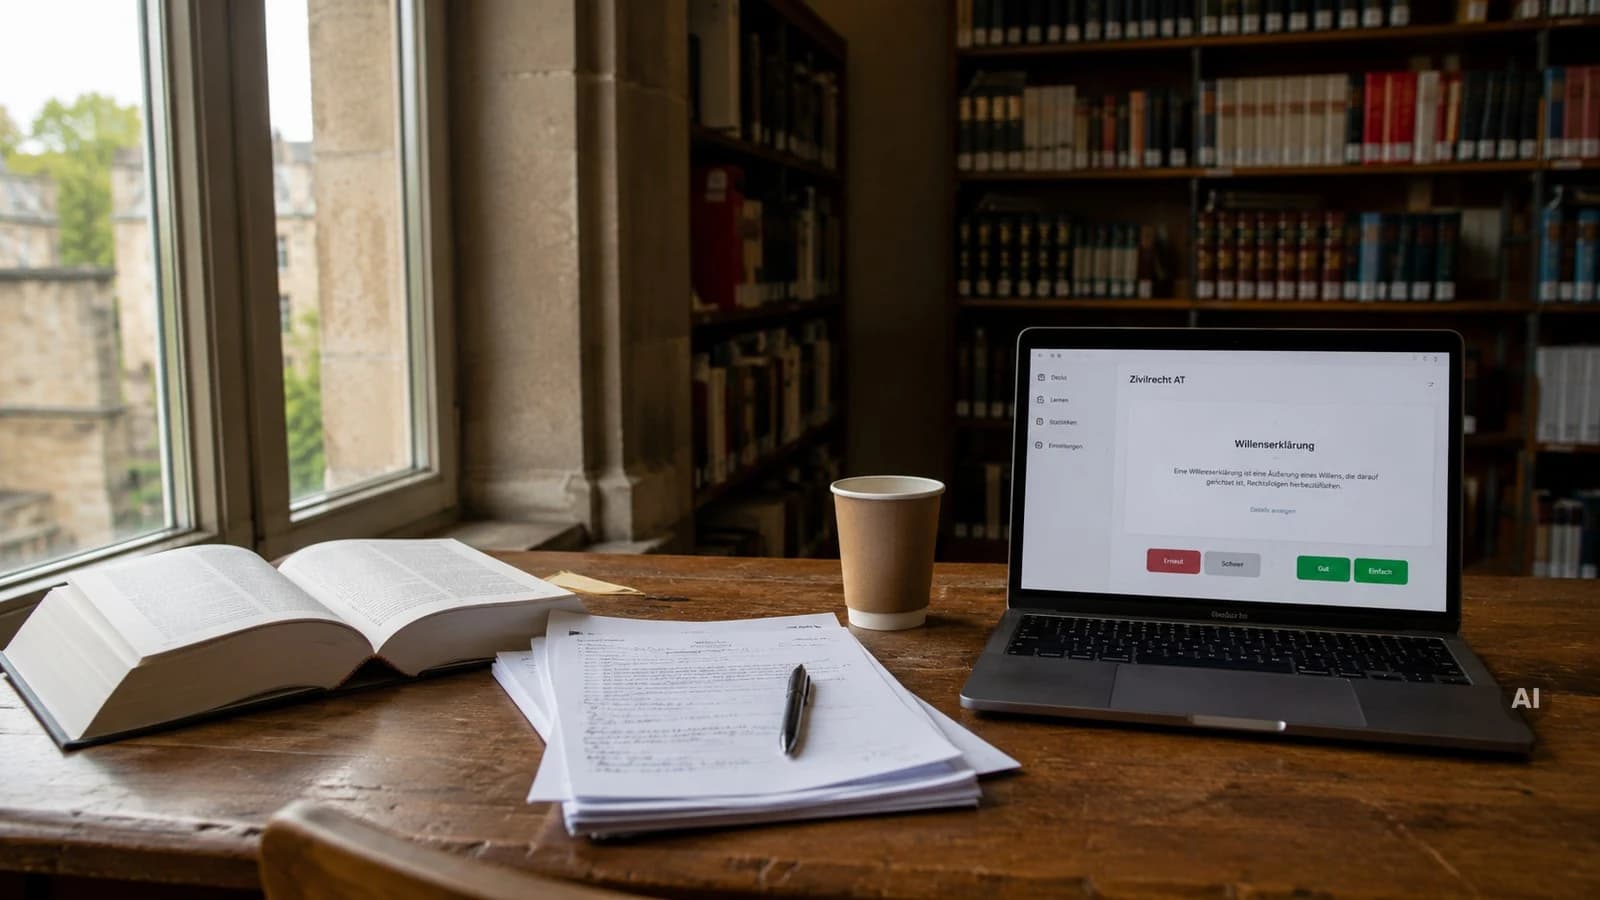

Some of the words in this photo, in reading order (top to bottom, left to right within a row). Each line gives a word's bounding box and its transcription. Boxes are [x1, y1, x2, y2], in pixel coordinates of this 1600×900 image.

[1129, 374, 1171, 385] Zivilrecht
[1173, 375, 1186, 385] AT
[1234, 439, 1315, 452] Willenserklärung
[1318, 472, 1344, 480] Willens,
[1317, 565, 1329, 573] Gut
[1368, 567, 1393, 576] Einfach
